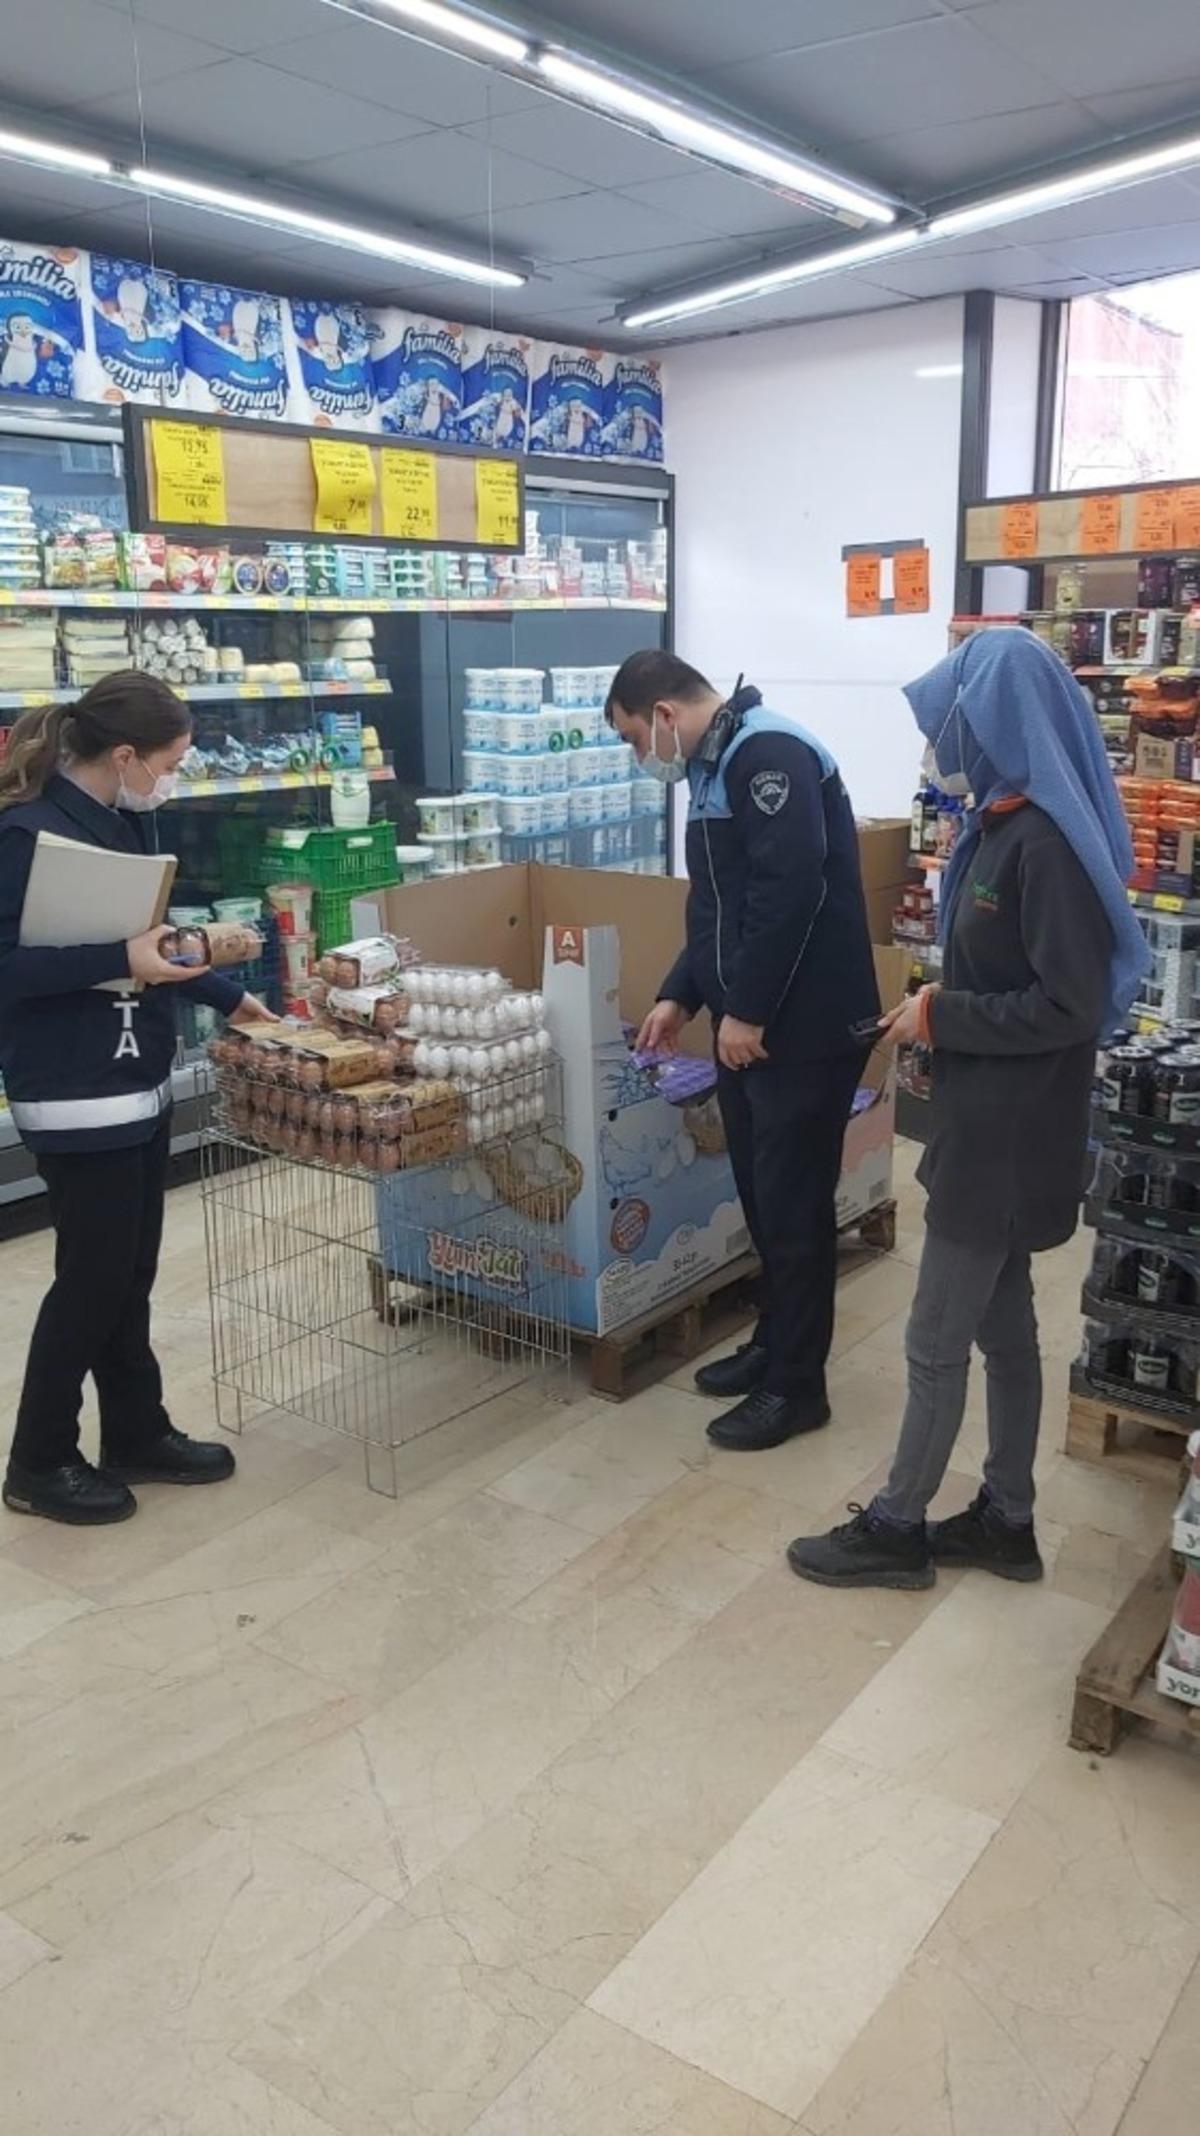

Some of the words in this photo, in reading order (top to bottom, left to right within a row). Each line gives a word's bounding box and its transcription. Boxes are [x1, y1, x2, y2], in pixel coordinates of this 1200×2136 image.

[402, 326, 463, 365] familia
[102, 355, 182, 397] familia
[550, 354, 603, 388] familia
[209, 377, 288, 417] familia
[309, 383, 374, 417] familia
